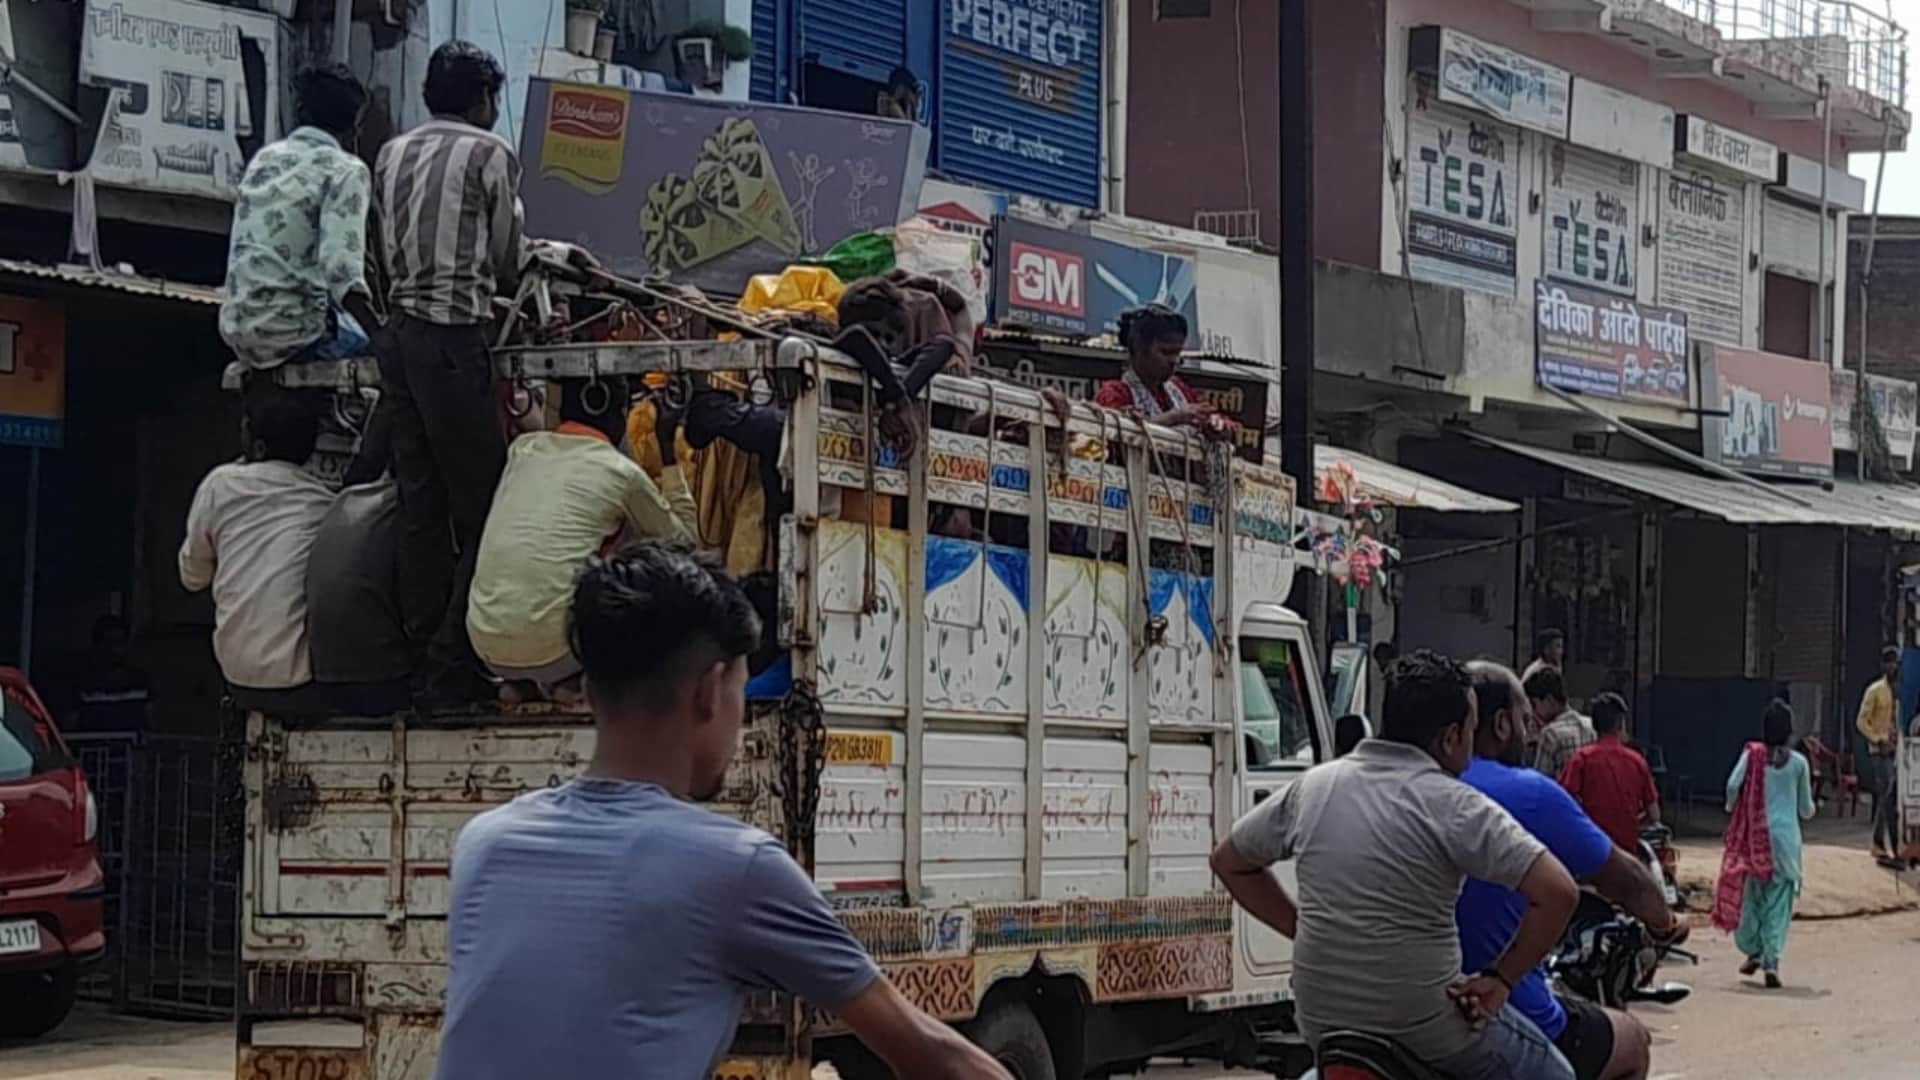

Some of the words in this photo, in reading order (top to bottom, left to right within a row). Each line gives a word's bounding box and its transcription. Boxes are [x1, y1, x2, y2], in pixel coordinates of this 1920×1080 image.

[952, 0, 1088, 66] PERFECT
[1018, 71, 1055, 102] PLUS
[1420, 146, 1506, 227] TESA
[1011, 252, 1080, 309] GM
[1553, 215, 1629, 287] TESA
[1537, 281, 1595, 337] देविका
[1599, 300, 1641, 347] ऑटो
